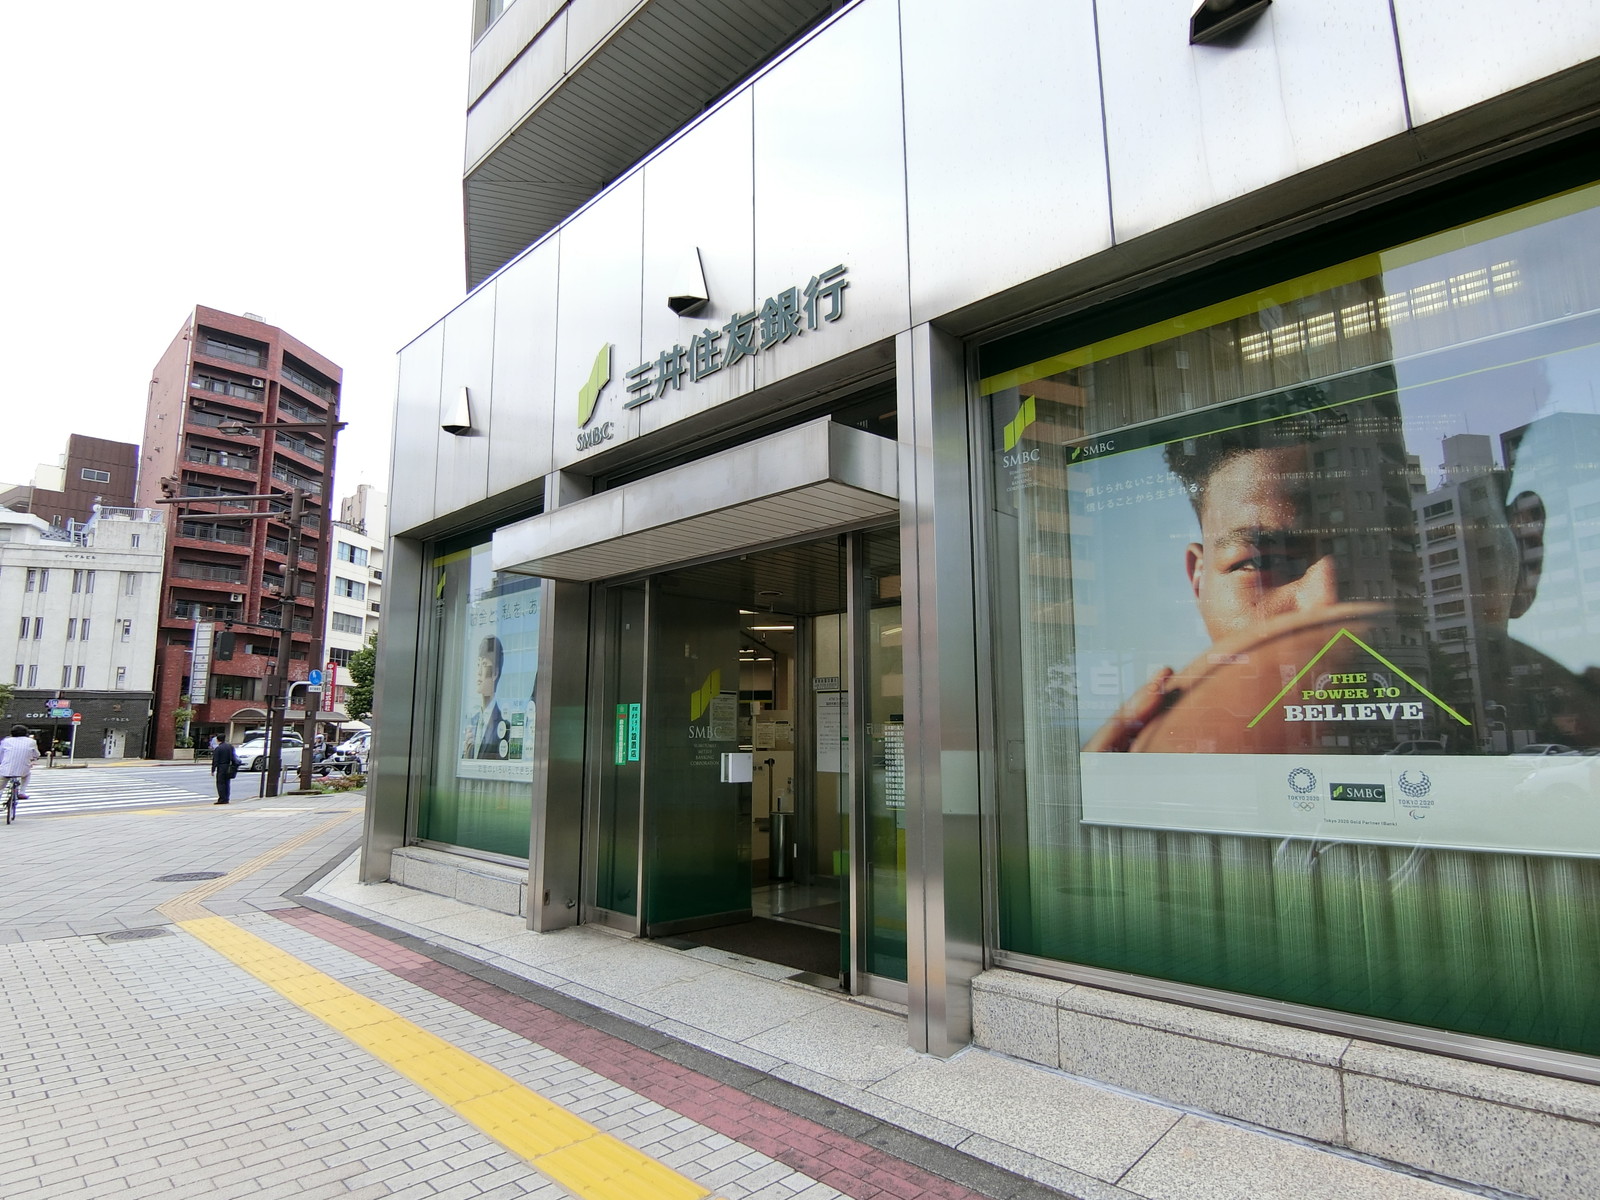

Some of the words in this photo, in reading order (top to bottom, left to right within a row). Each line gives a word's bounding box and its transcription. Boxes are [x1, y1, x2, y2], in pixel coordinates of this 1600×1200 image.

[623, 264, 850, 409] 三井住友銀行
[575, 422, 614, 451] SMBC
[1003, 448, 1040, 468] SMBC
[1083, 441, 1115, 457] SMBC
[1085, 471, 1182, 497] 信じられないことは、
[1086, 483, 1204, 513] 信じることから生まれる。
[1329, 673, 1367, 685] THE
[1302, 688, 1369, 700] POWER
[1373, 687, 1400, 698] TO
[1283, 702, 1424, 722] BELIEVE
[688, 725, 722, 739] SMBC
[1346, 788, 1383, 799] SMBC
